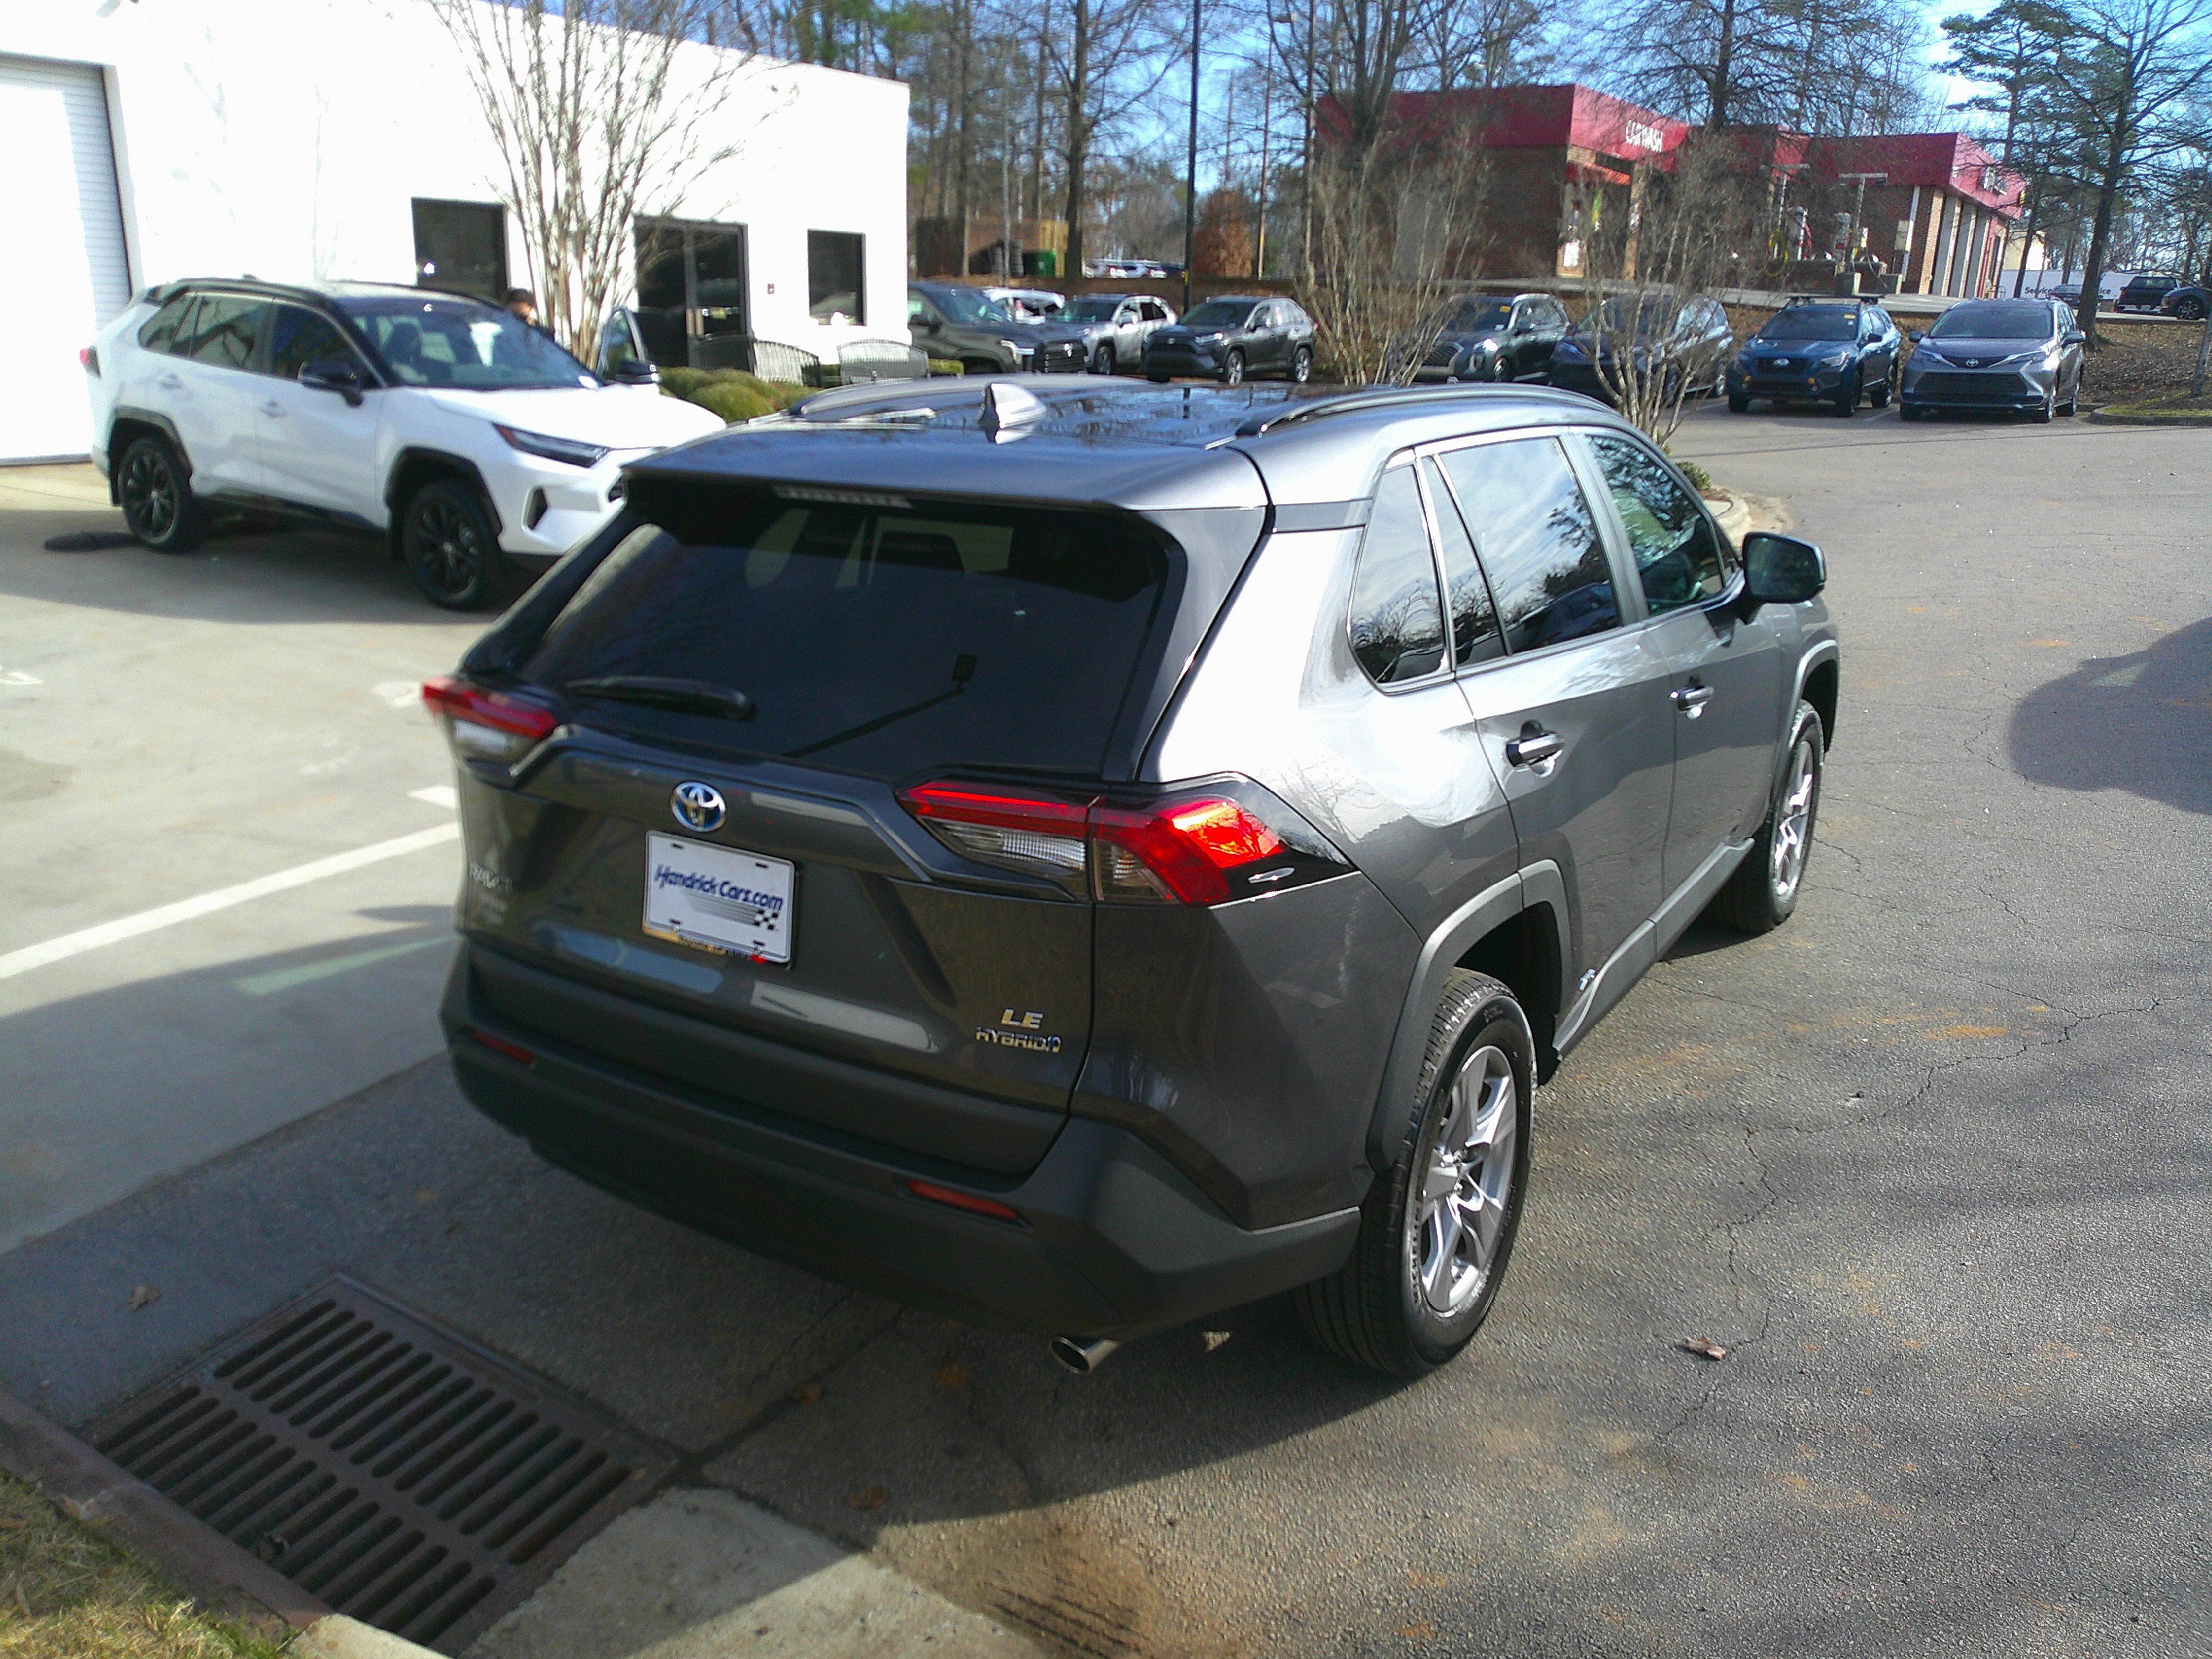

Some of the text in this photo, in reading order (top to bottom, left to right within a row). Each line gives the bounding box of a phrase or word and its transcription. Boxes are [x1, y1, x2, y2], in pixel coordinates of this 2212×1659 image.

[654, 864, 784, 911] HendrickCars.com
[1001, 1008, 1044, 1030] LE
[974, 1026, 1047, 1051] HYBRID
